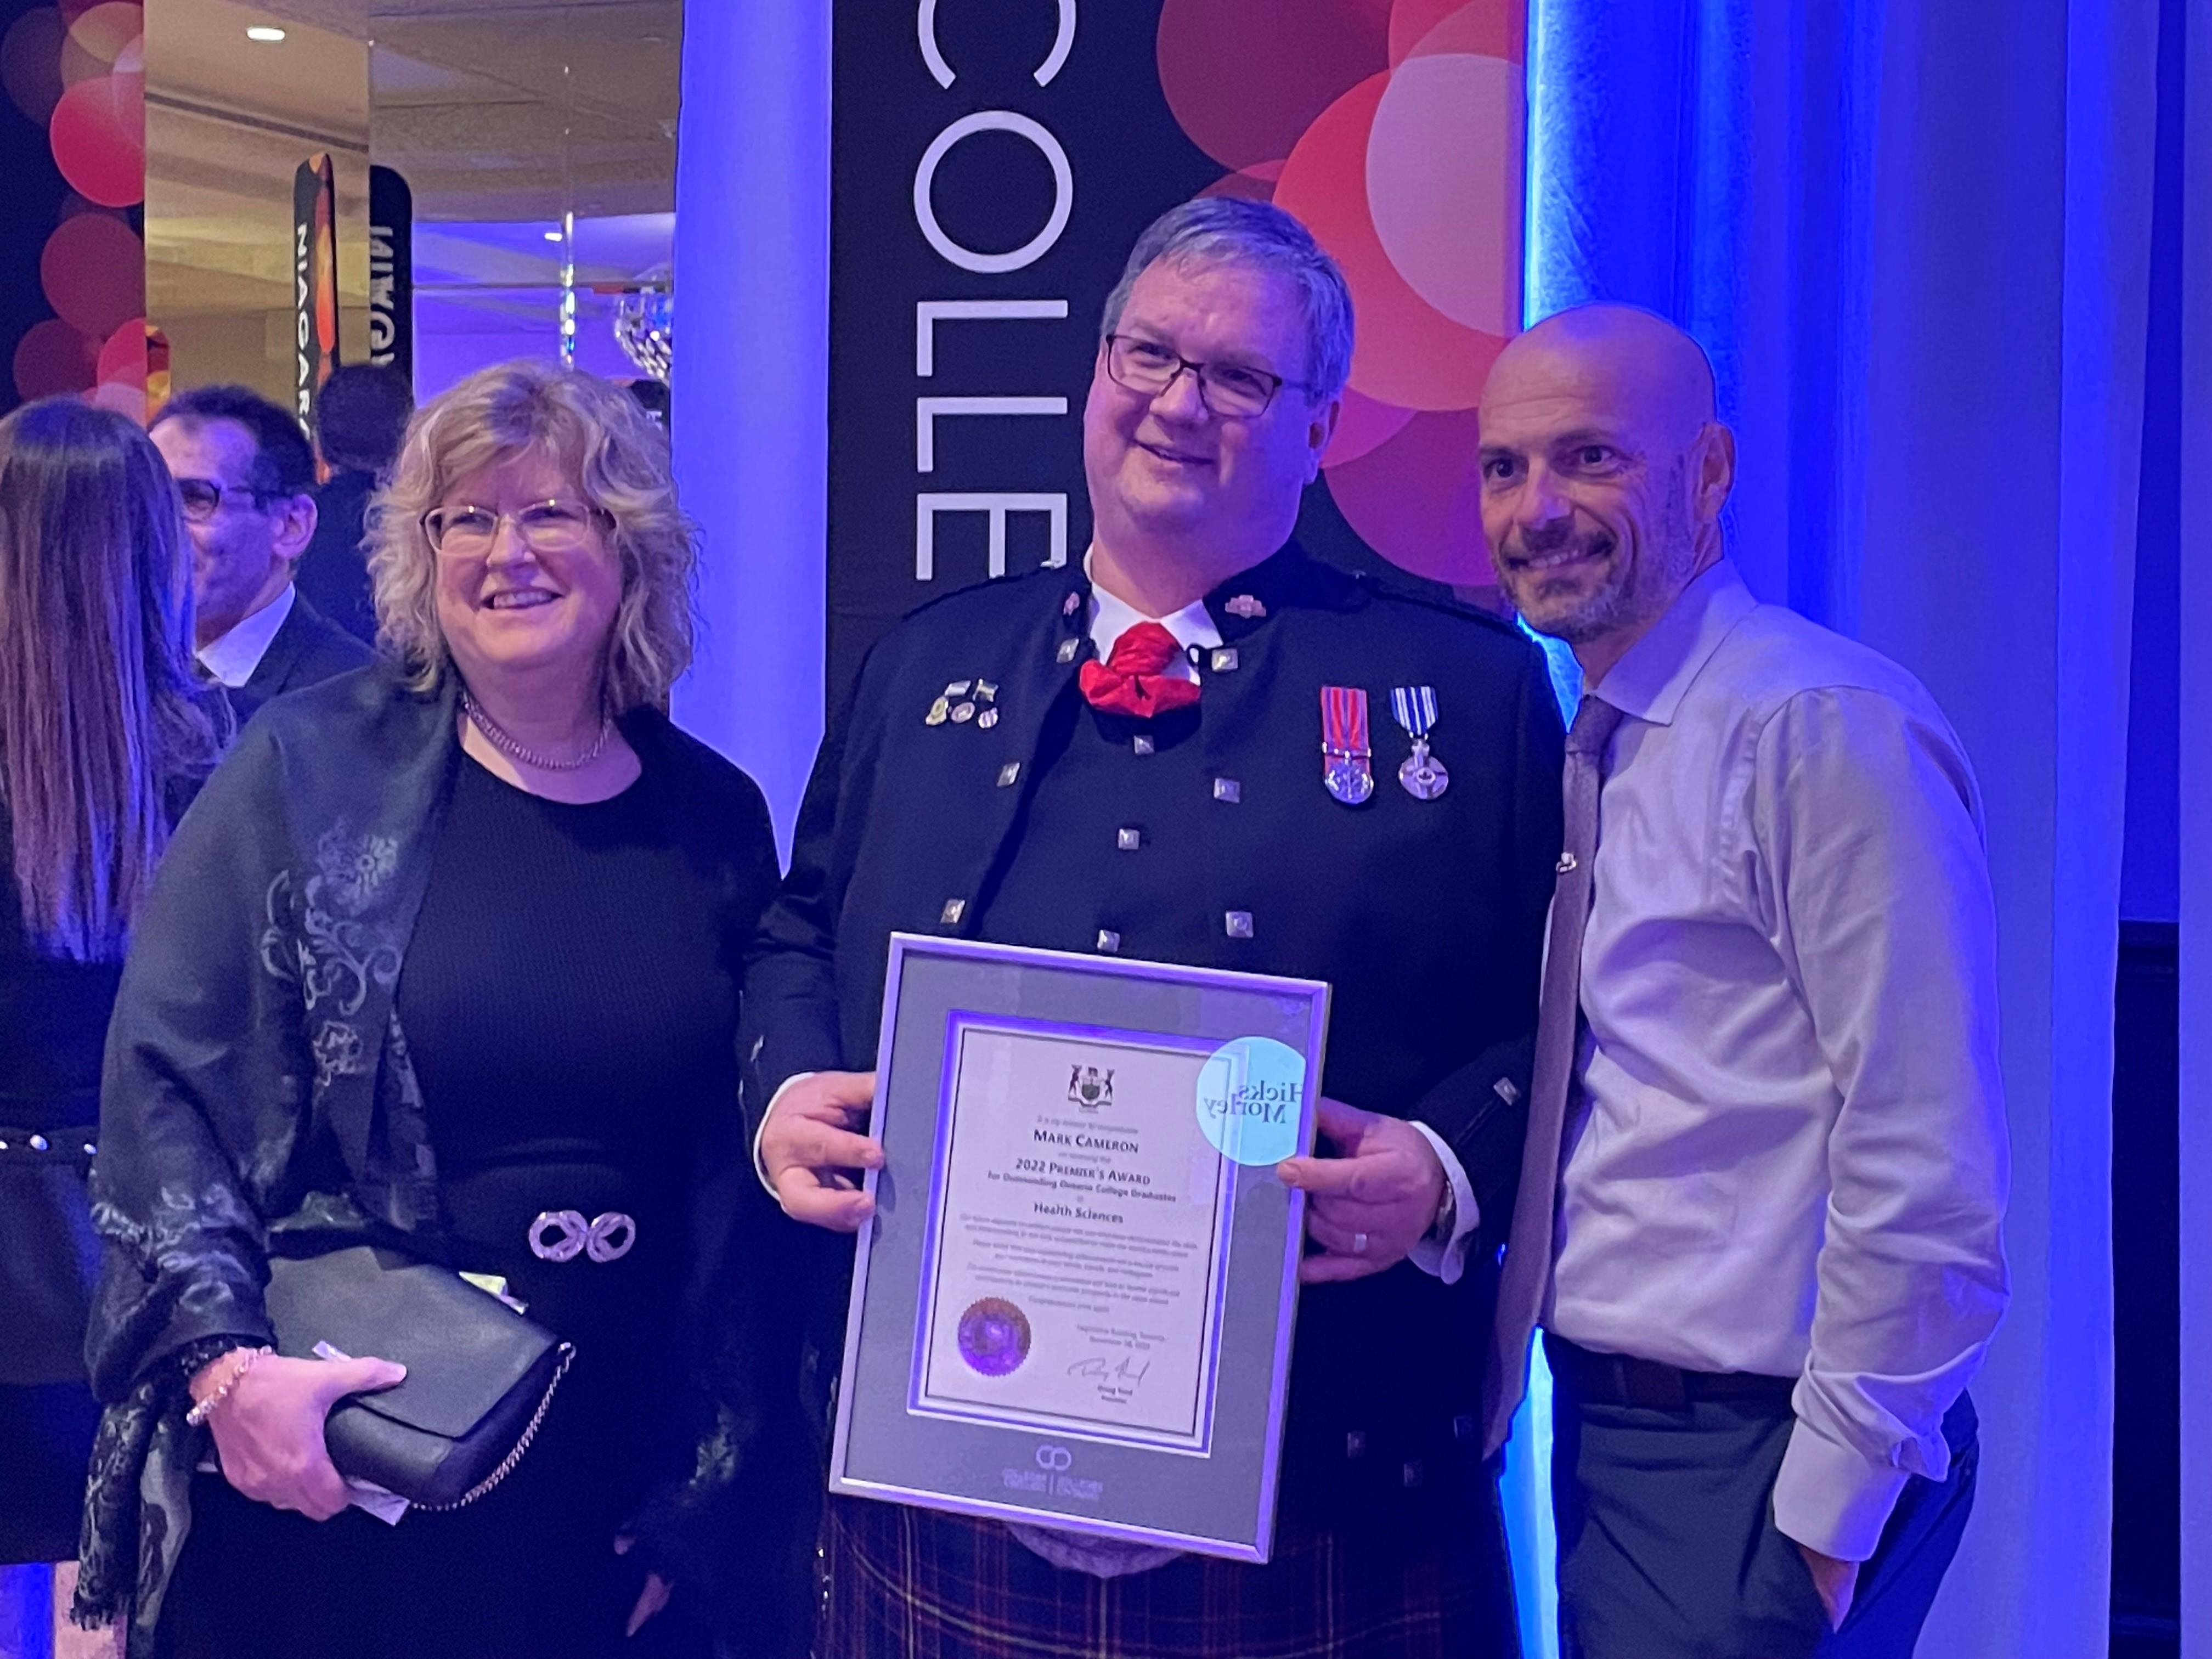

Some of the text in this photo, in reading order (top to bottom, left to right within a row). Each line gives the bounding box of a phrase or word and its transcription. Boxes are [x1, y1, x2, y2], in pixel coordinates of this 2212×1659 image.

[913, 0, 1076, 581] COLLE
[1034, 1128, 1139, 1153] MARK CAMERON
[1015, 1158, 1046, 1173] 2022
[1108, 1170, 1150, 1185] AWARD
[1034, 1201, 1123, 1223] Health Sciences
